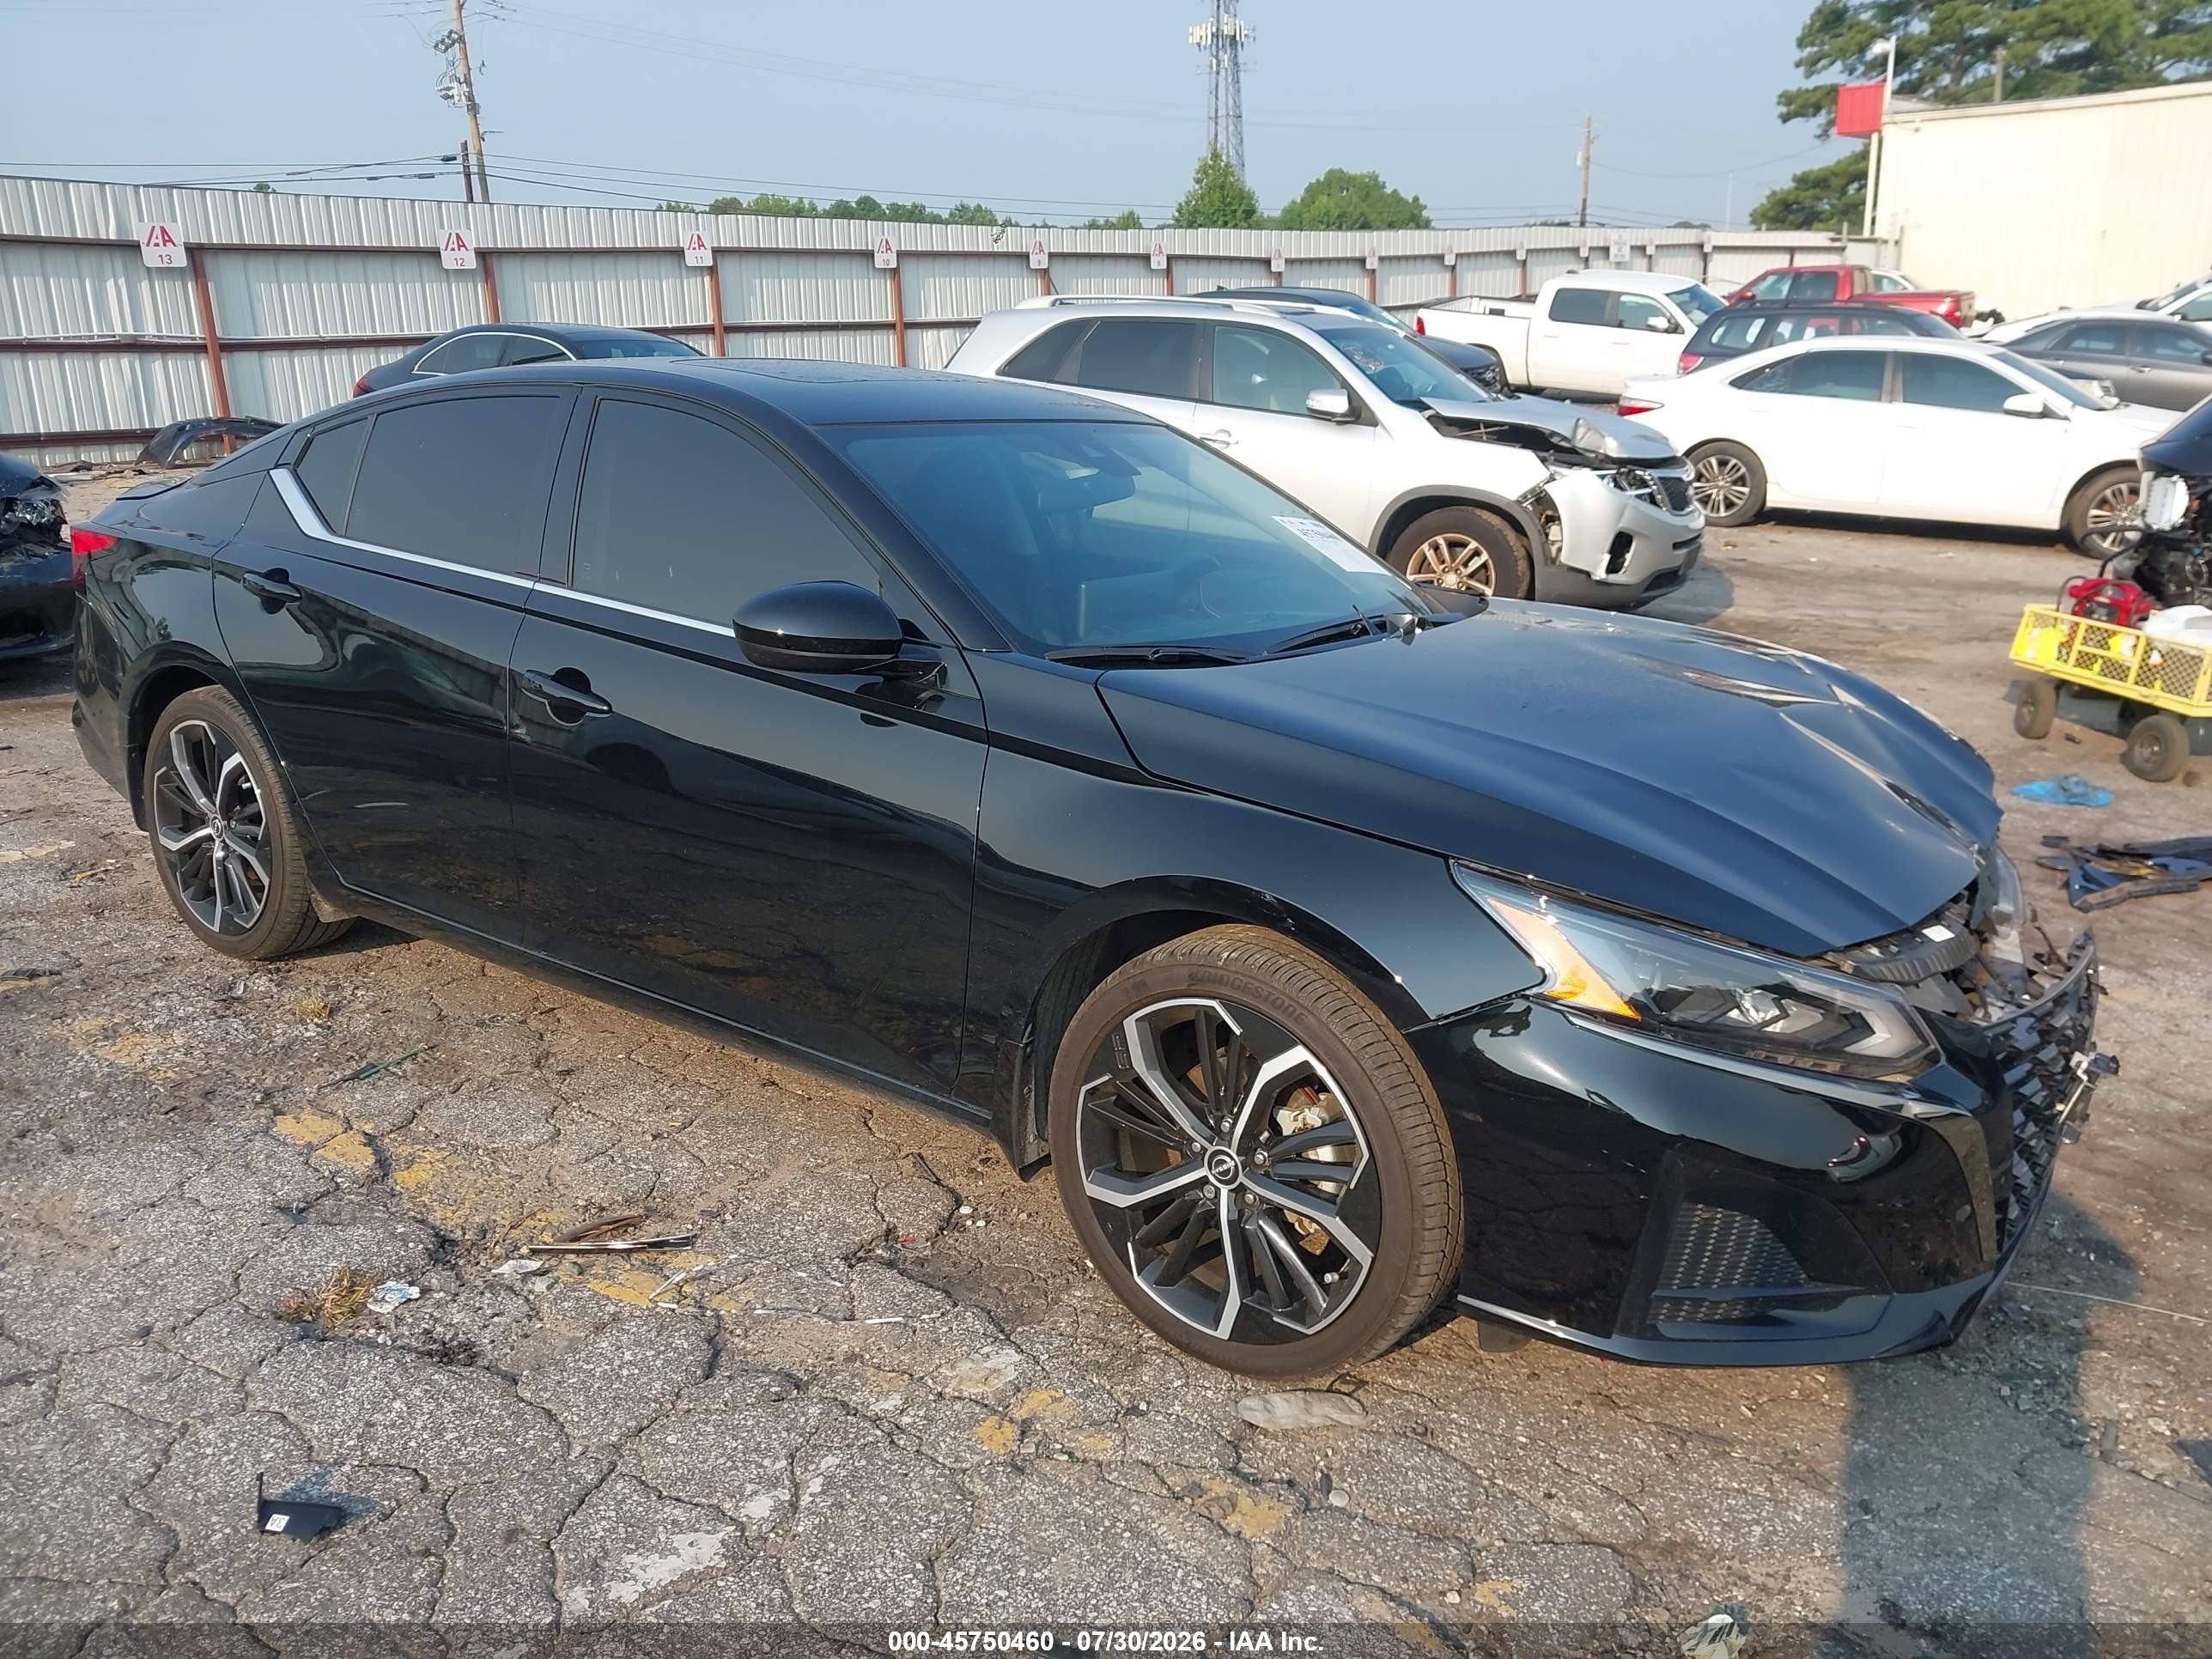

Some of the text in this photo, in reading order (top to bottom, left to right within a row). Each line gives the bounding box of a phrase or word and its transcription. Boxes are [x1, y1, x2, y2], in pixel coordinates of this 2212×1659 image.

[158, 254, 173, 264] 13
[453, 258, 465, 267] 12
[695, 256, 703, 264] 11
[882, 258, 890, 267] 10
